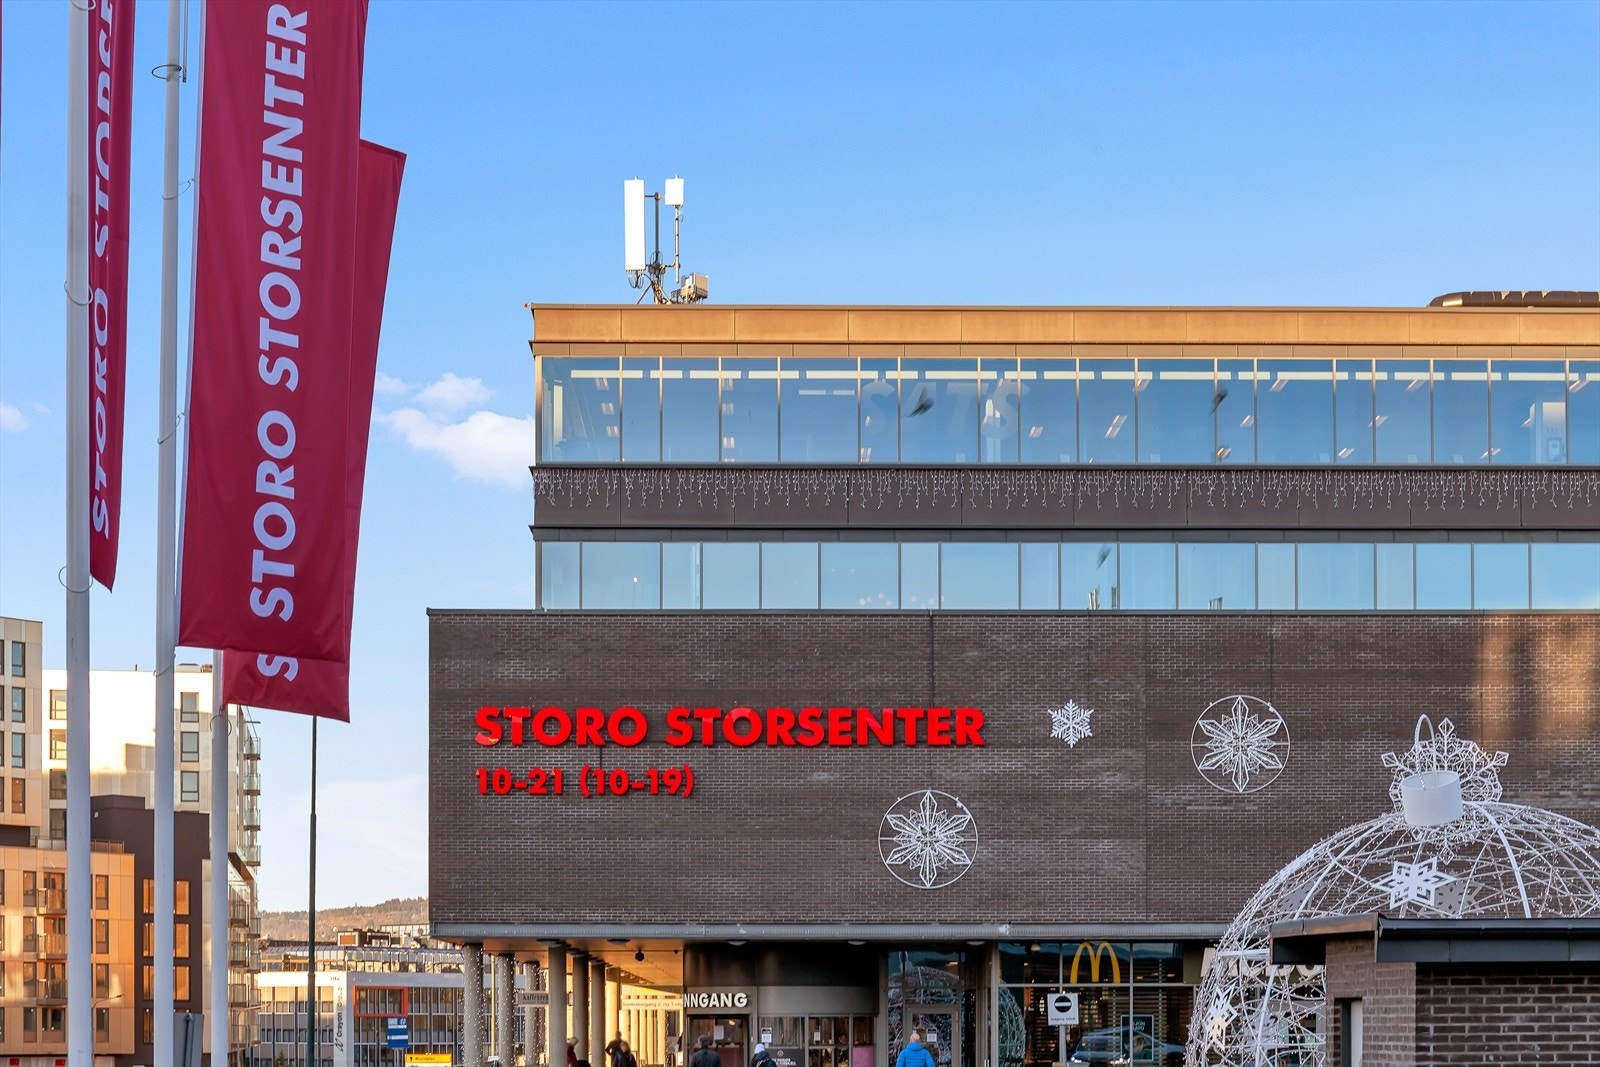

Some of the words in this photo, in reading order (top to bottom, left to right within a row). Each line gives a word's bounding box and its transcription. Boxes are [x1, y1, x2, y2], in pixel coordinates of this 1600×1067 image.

[258, 3, 309, 392] STORSENTER
[92, 287, 109, 540] STORO
[249, 410, 298, 622] STORO
[475, 706, 648, 746] STORO
[666, 706, 985, 746] STORSENTER
[475, 768, 563, 796] 10-21
[579, 765, 695, 797] (10-19)
[336, 1012, 345, 1038] Crayon
